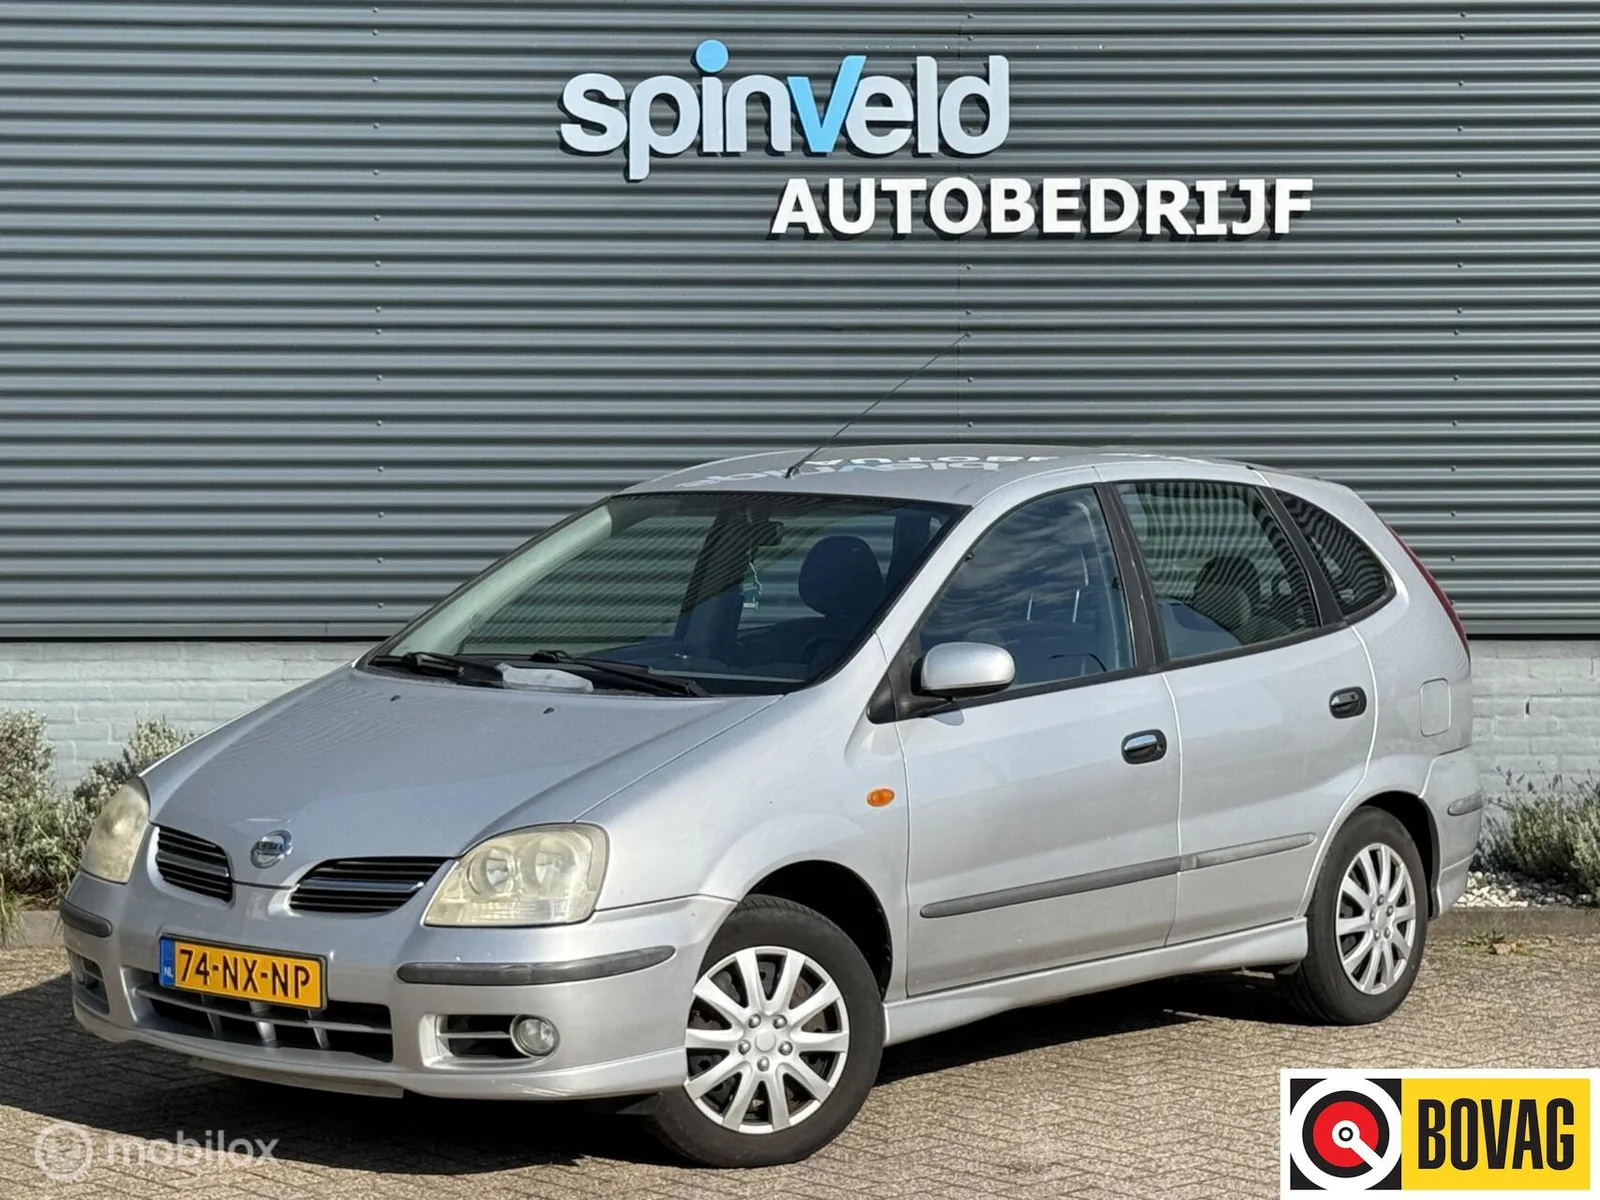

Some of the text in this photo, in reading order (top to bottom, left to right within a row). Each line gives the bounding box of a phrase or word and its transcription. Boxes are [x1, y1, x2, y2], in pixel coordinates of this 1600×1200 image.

[560, 39, 1010, 180] spinveld
[771, 177, 1314, 236] AUTOBEDRIJF
[164, 948, 311, 999] NL 74-NX-NP
